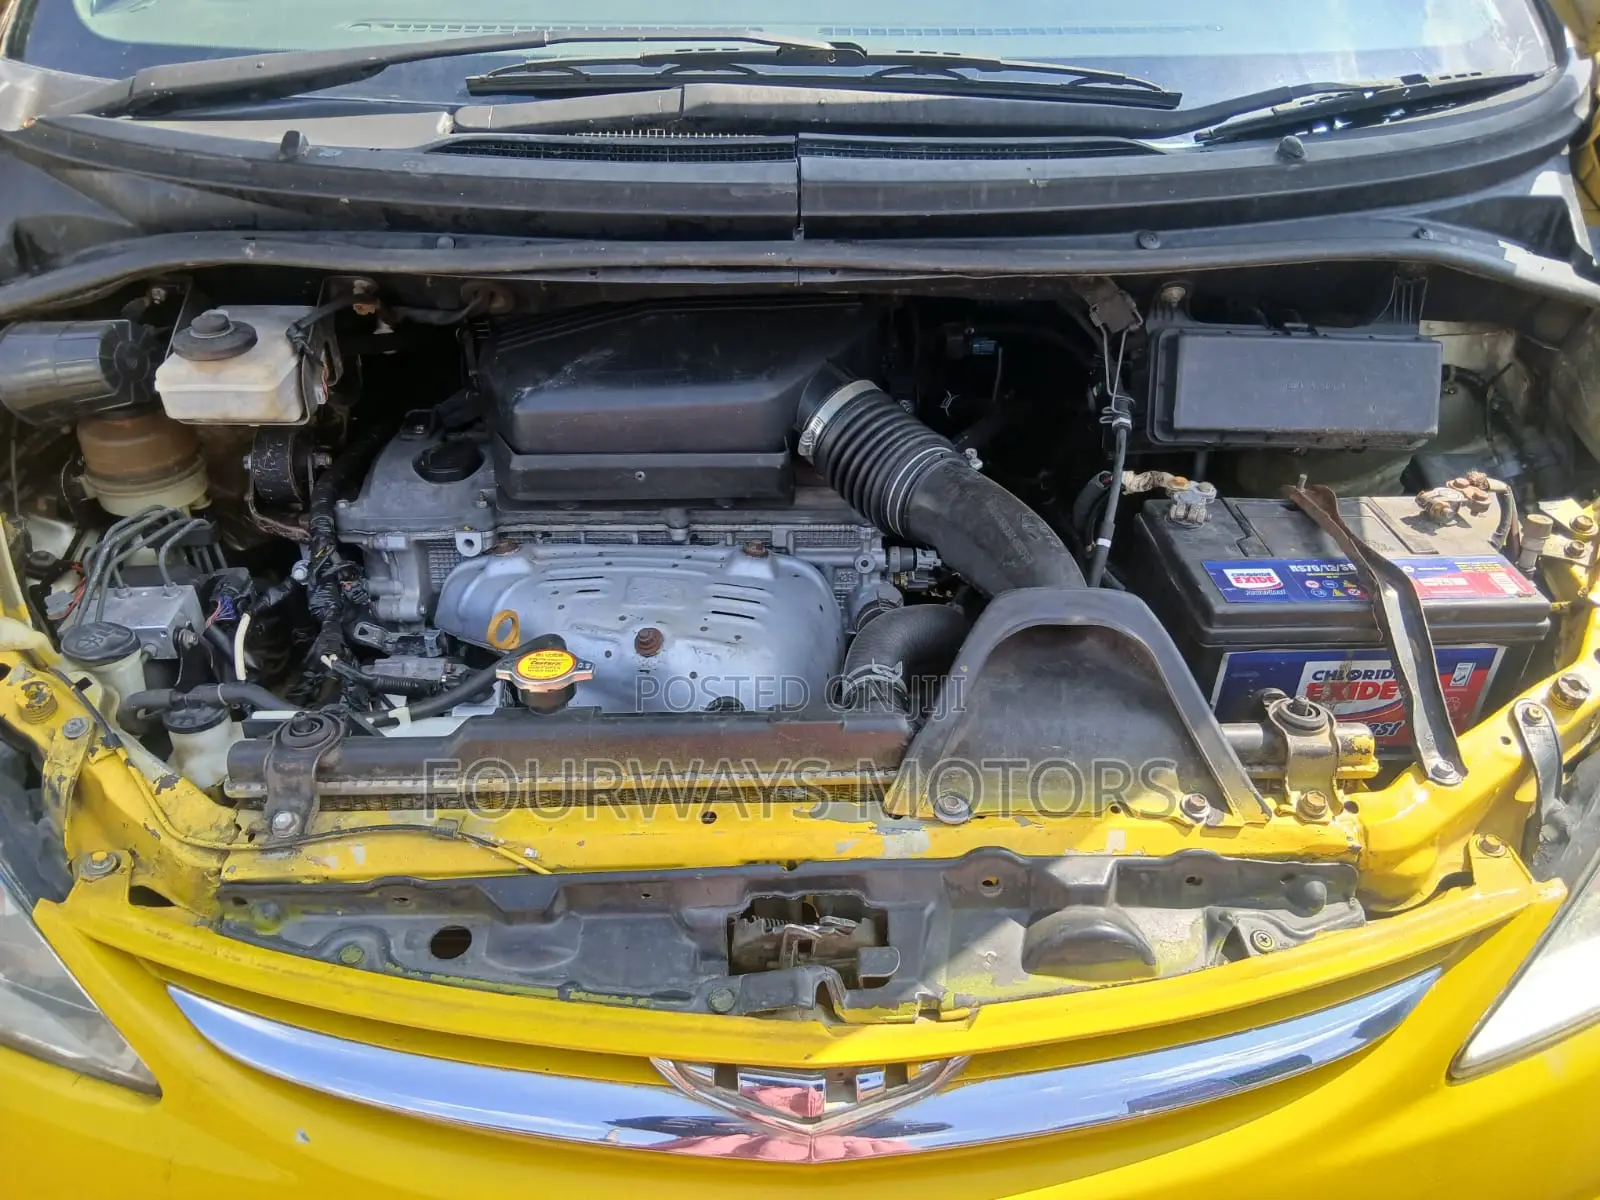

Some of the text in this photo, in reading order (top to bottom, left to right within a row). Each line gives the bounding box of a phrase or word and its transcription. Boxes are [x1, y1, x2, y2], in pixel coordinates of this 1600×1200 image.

[1233, 576, 1276, 584] EXIDE
[1312, 669, 1396, 680] CHLORID
[1306, 681, 1398, 701] EXIDE
